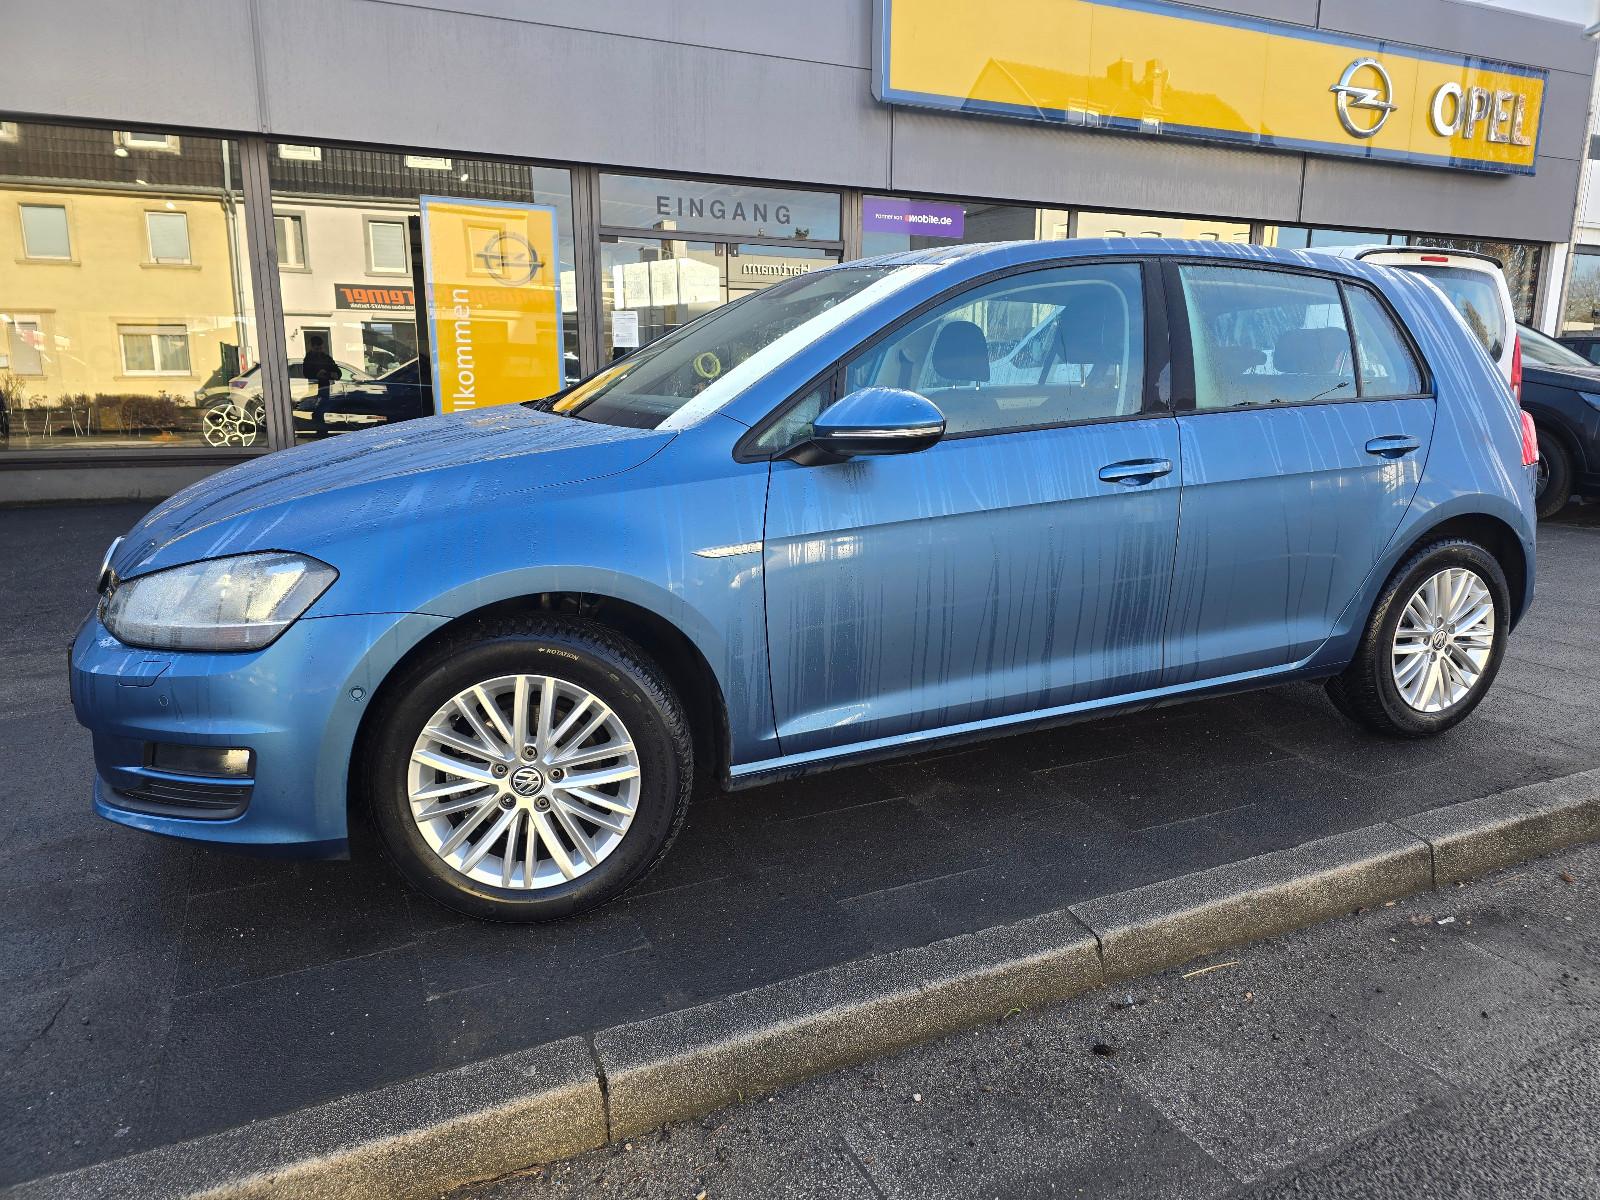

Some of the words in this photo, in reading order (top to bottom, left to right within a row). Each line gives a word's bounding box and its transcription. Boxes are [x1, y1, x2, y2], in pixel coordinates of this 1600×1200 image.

[1430, 81, 1532, 146] OPEL
[656, 195, 791, 225] EINGANG
[908, 214, 953, 225] mobile.de
[546, 648, 580, 661] ROTATION
